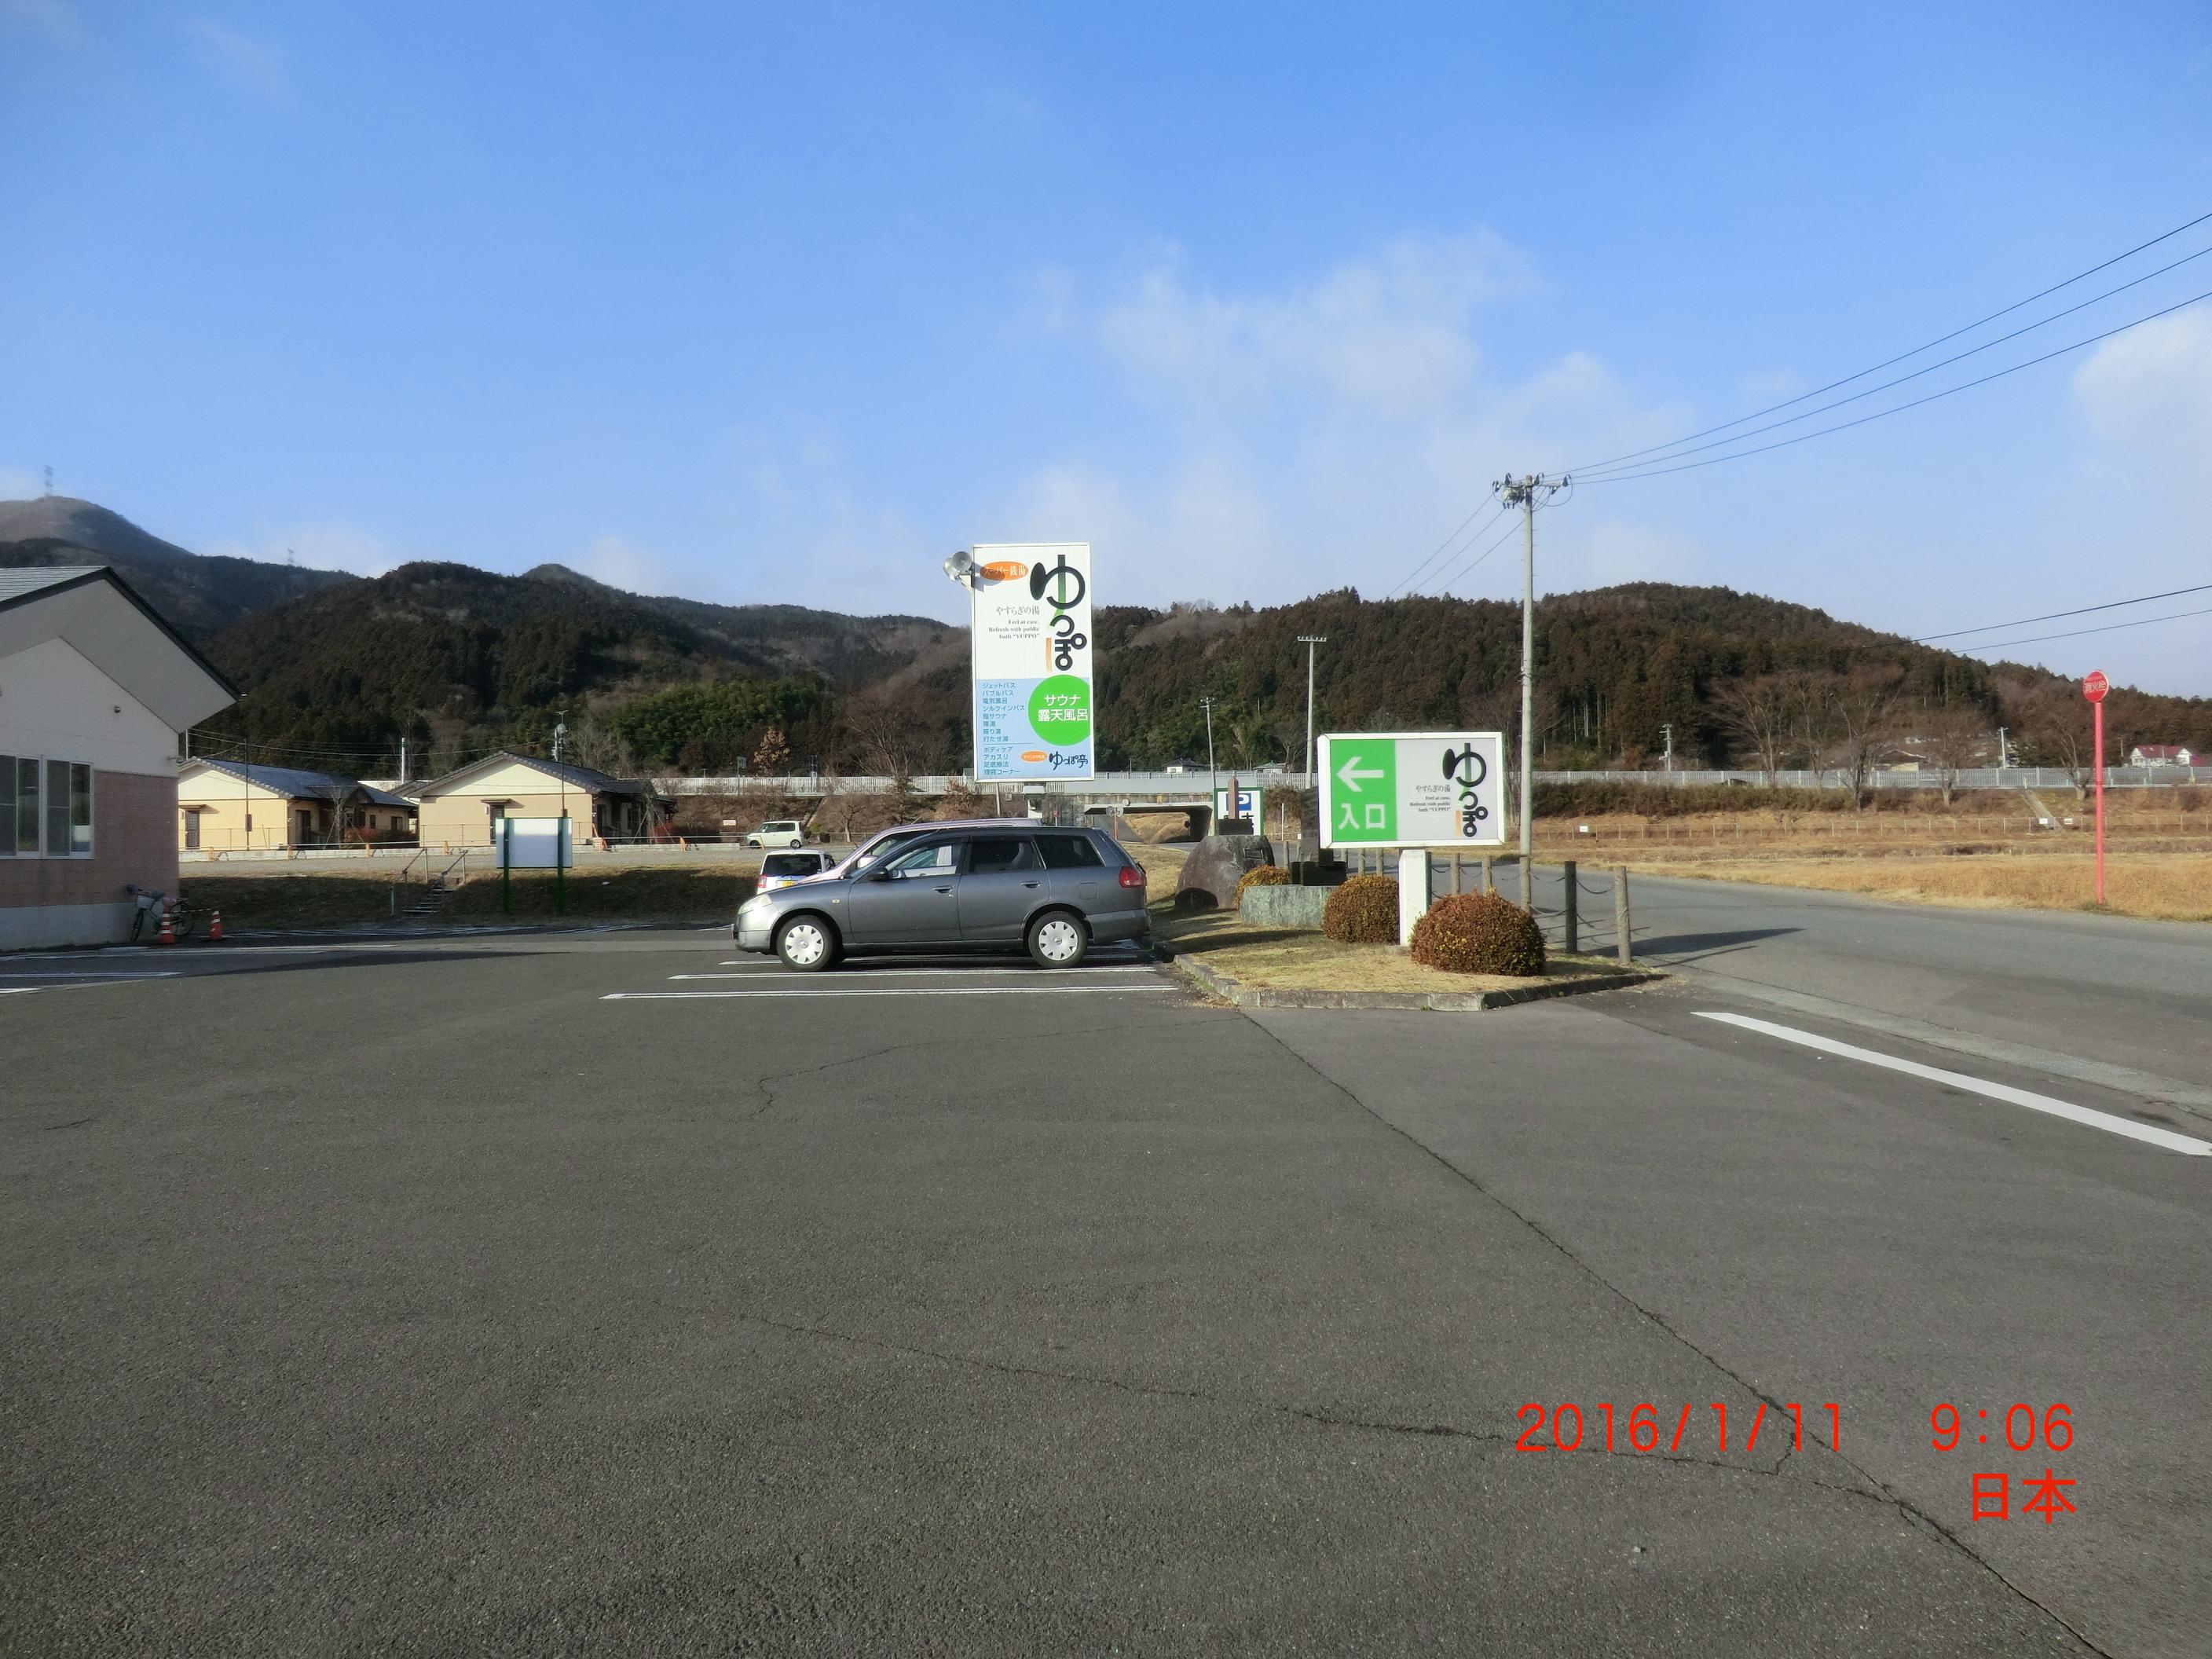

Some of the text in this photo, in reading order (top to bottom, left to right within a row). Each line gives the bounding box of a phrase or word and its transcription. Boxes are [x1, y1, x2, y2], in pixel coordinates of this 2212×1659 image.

[995, 606, 1040, 616] やすらぎの湯
[1044, 694, 1081, 706] サウナ
[1038, 709, 1089, 722] 露天風呂
[1049, 751, 1089, 771] ゆっぽ亭
[1339, 804, 1385, 830] 入口
